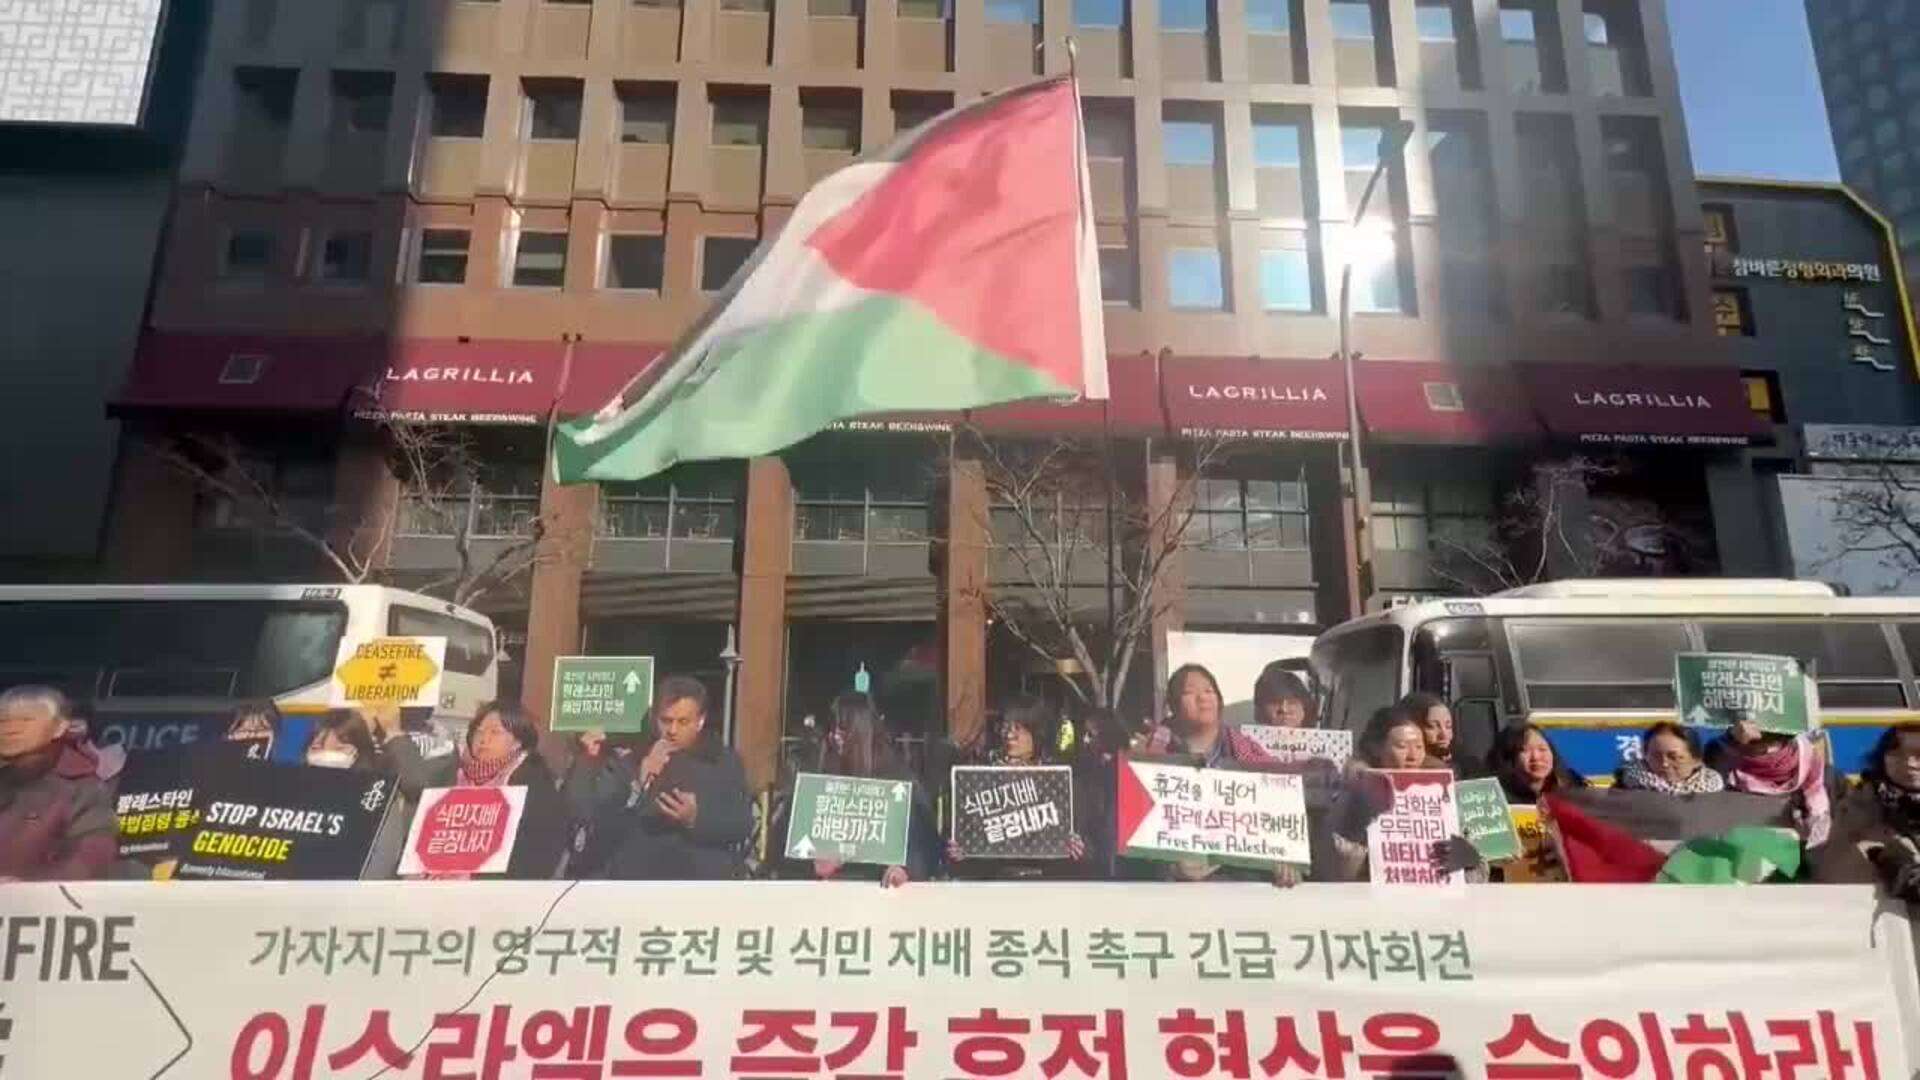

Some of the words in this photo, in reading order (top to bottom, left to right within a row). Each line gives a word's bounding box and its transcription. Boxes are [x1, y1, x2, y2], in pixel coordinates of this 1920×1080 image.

[386, 367, 534, 384] LAGRILLIA
[1188, 385, 1328, 400] LAGRILLIA
[1573, 393, 1712, 408] LAGRILLIA
[355, 643, 426, 660] CEASEFIRE
[344, 683, 421, 701] LIBERATION
[101, 724, 199, 750] OLICE
[1616, 734, 1643, 761] 경
[964, 777, 1039, 817] 식민지배
[1395, 794, 1442, 817] 단학살
[205, 801, 259, 827] STOP
[259, 807, 344, 835] ISRAEL'S
[434, 802, 501, 828] 식민지배
[983, 800, 1060, 844] 끝장내자
[811, 816, 887, 845] 해방까지
[1157, 831, 1189, 848] Free
[1191, 834, 1222, 851] Free
[1380, 819, 1447, 841] 우두머리
[193, 830, 294, 861] GENOCIDE
[0, 916, 134, 981] FIRE
[250, 925, 476, 977] 가자지구의
[492, 925, 622, 977] 영구적
[633, 925, 721, 977] 휴전
[735, 926, 775, 977] 및
[789, 926, 873, 978] 식민
[887, 926, 972, 978] 지배
[985, 927, 1072, 979] 종식
[1086, 926, 1175, 980] 촉구
[1188, 928, 1278, 980] 긴급
[1290, 928, 1474, 982] 기자회견
